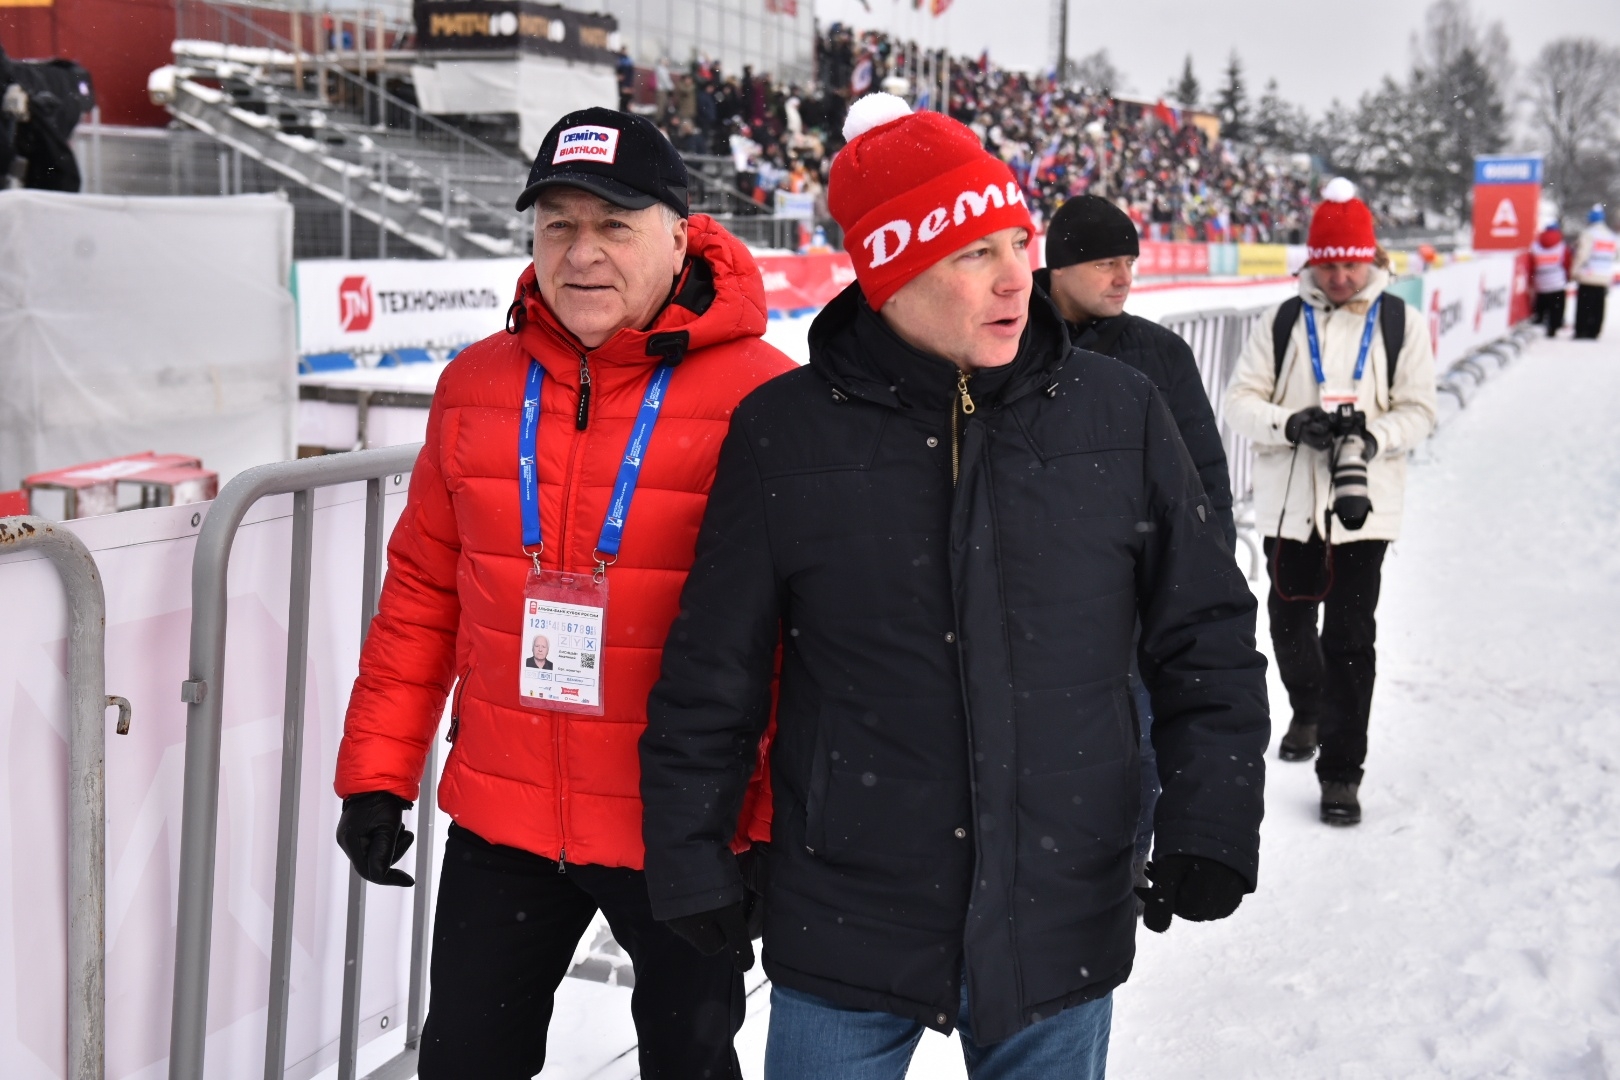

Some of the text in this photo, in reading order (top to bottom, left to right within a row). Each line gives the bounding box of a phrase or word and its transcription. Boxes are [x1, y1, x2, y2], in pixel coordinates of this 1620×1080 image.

[559, 145, 608, 156] BIATHLON
[377, 288, 499, 314] ТЕХНОНИКОЛЬ
[586, 640, 594, 648] X
